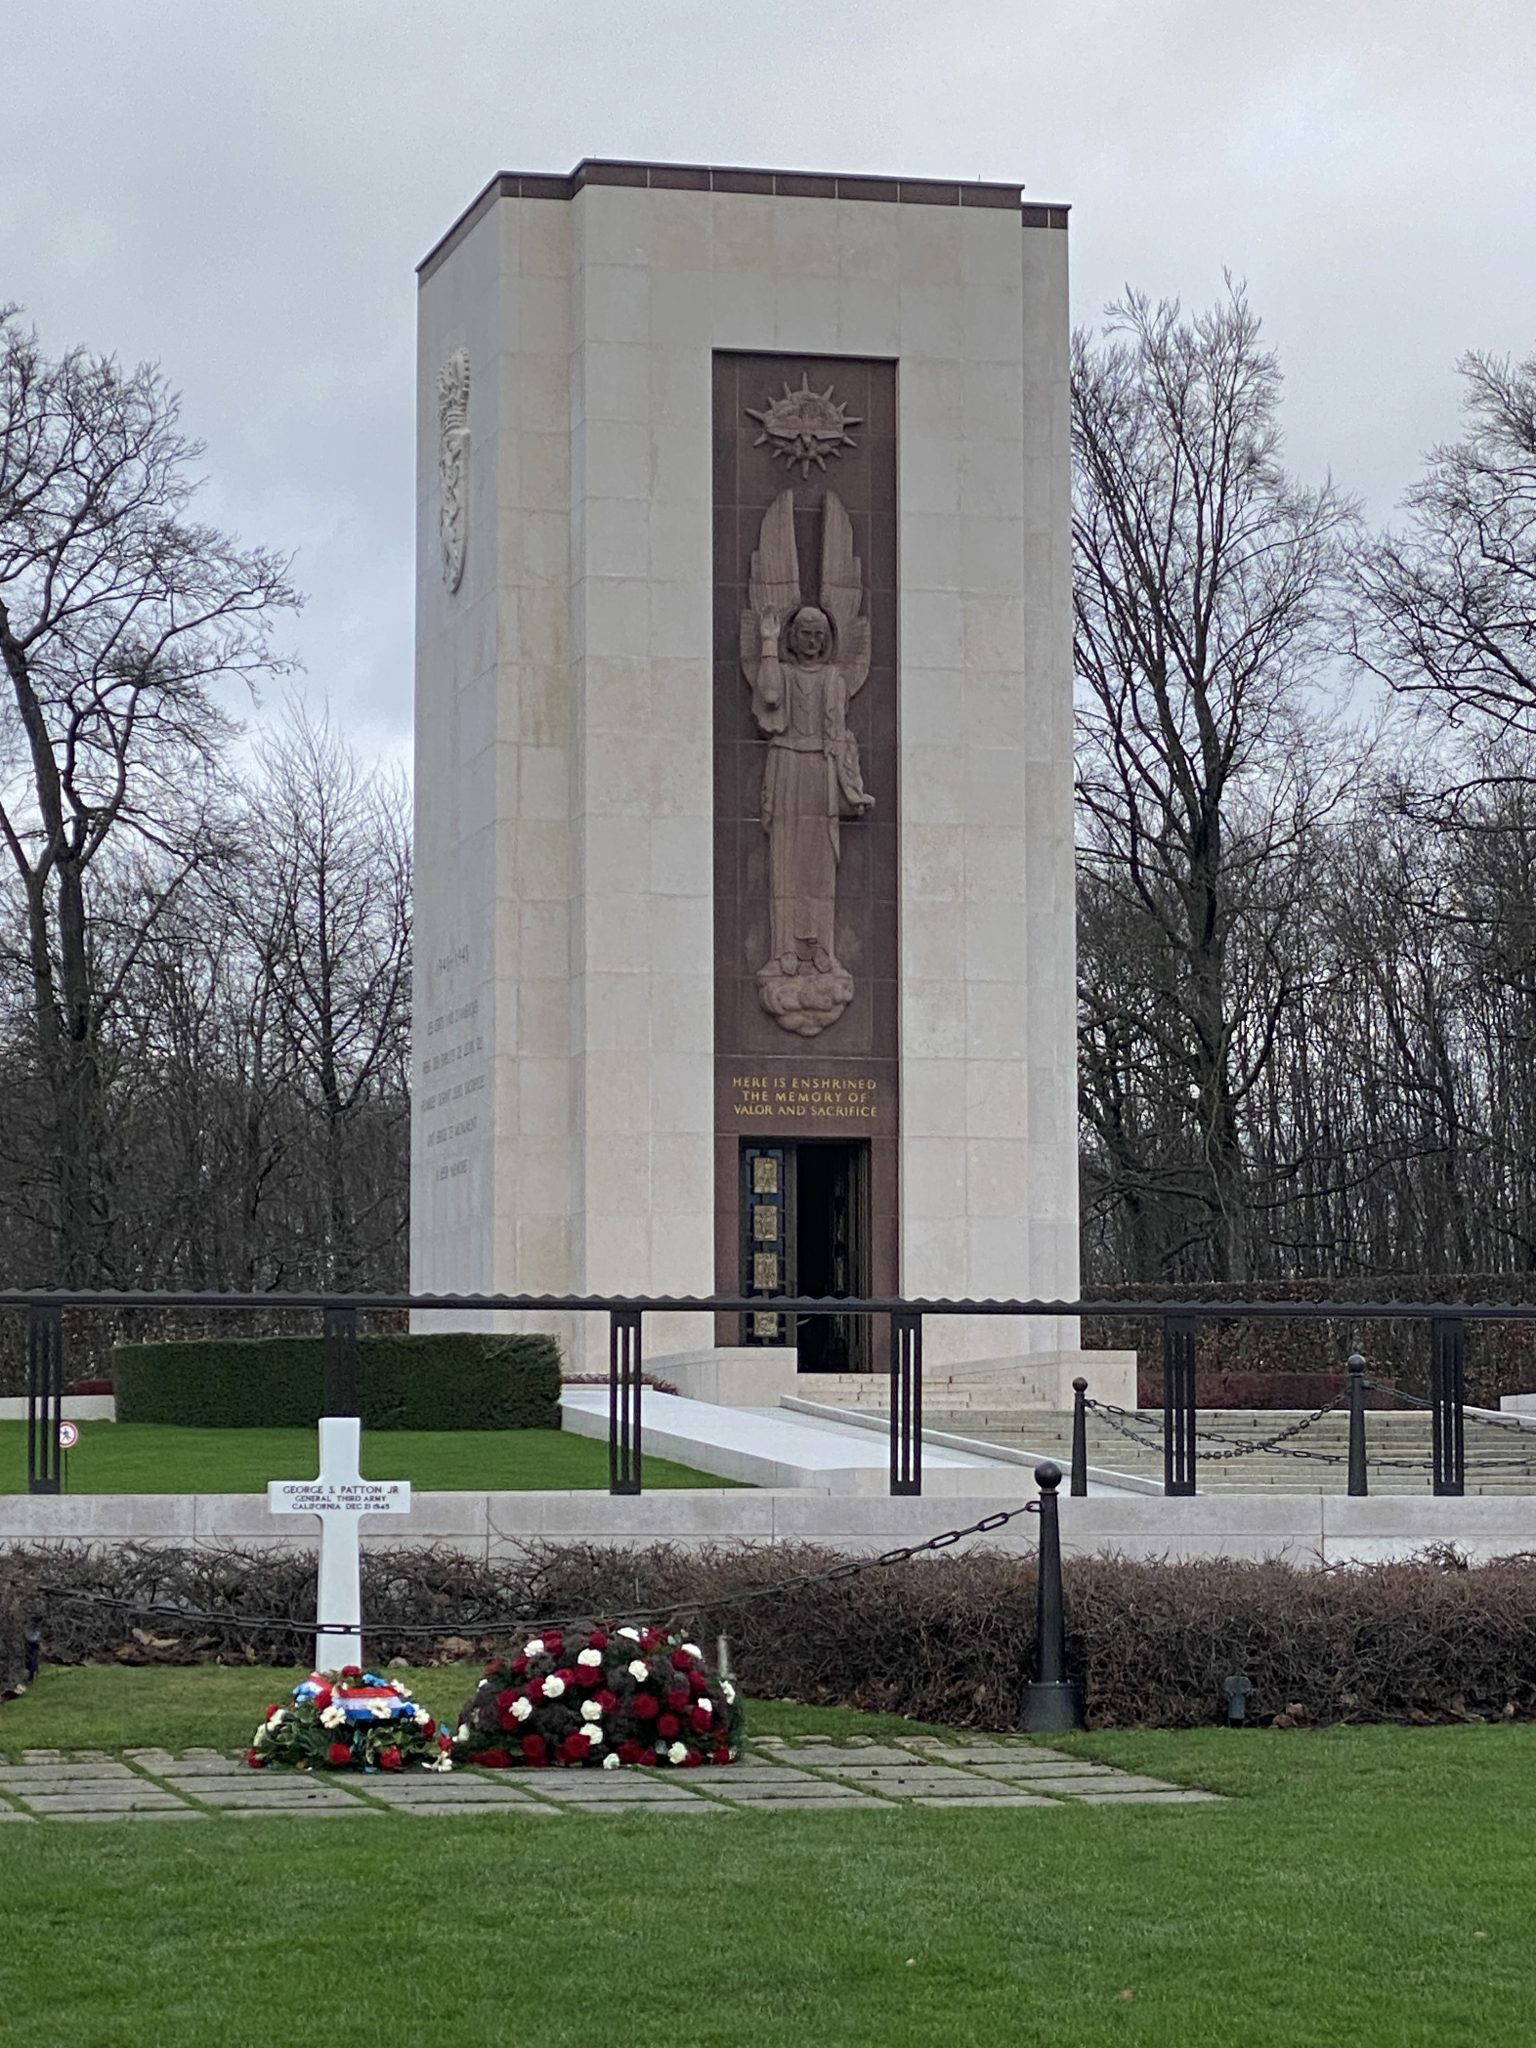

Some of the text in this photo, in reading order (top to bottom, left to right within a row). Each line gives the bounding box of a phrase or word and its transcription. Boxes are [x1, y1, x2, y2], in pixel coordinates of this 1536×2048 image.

[733, 1077, 876, 1090] HERE IS ENSHRINED
[742, 1091, 868, 1103] THE MEMORY OF
[734, 1104, 878, 1117] VALOR AND SACRIFICE
[283, 1486, 324, 1494] GEORGE
[340, 1486, 382, 1494] PATTON
